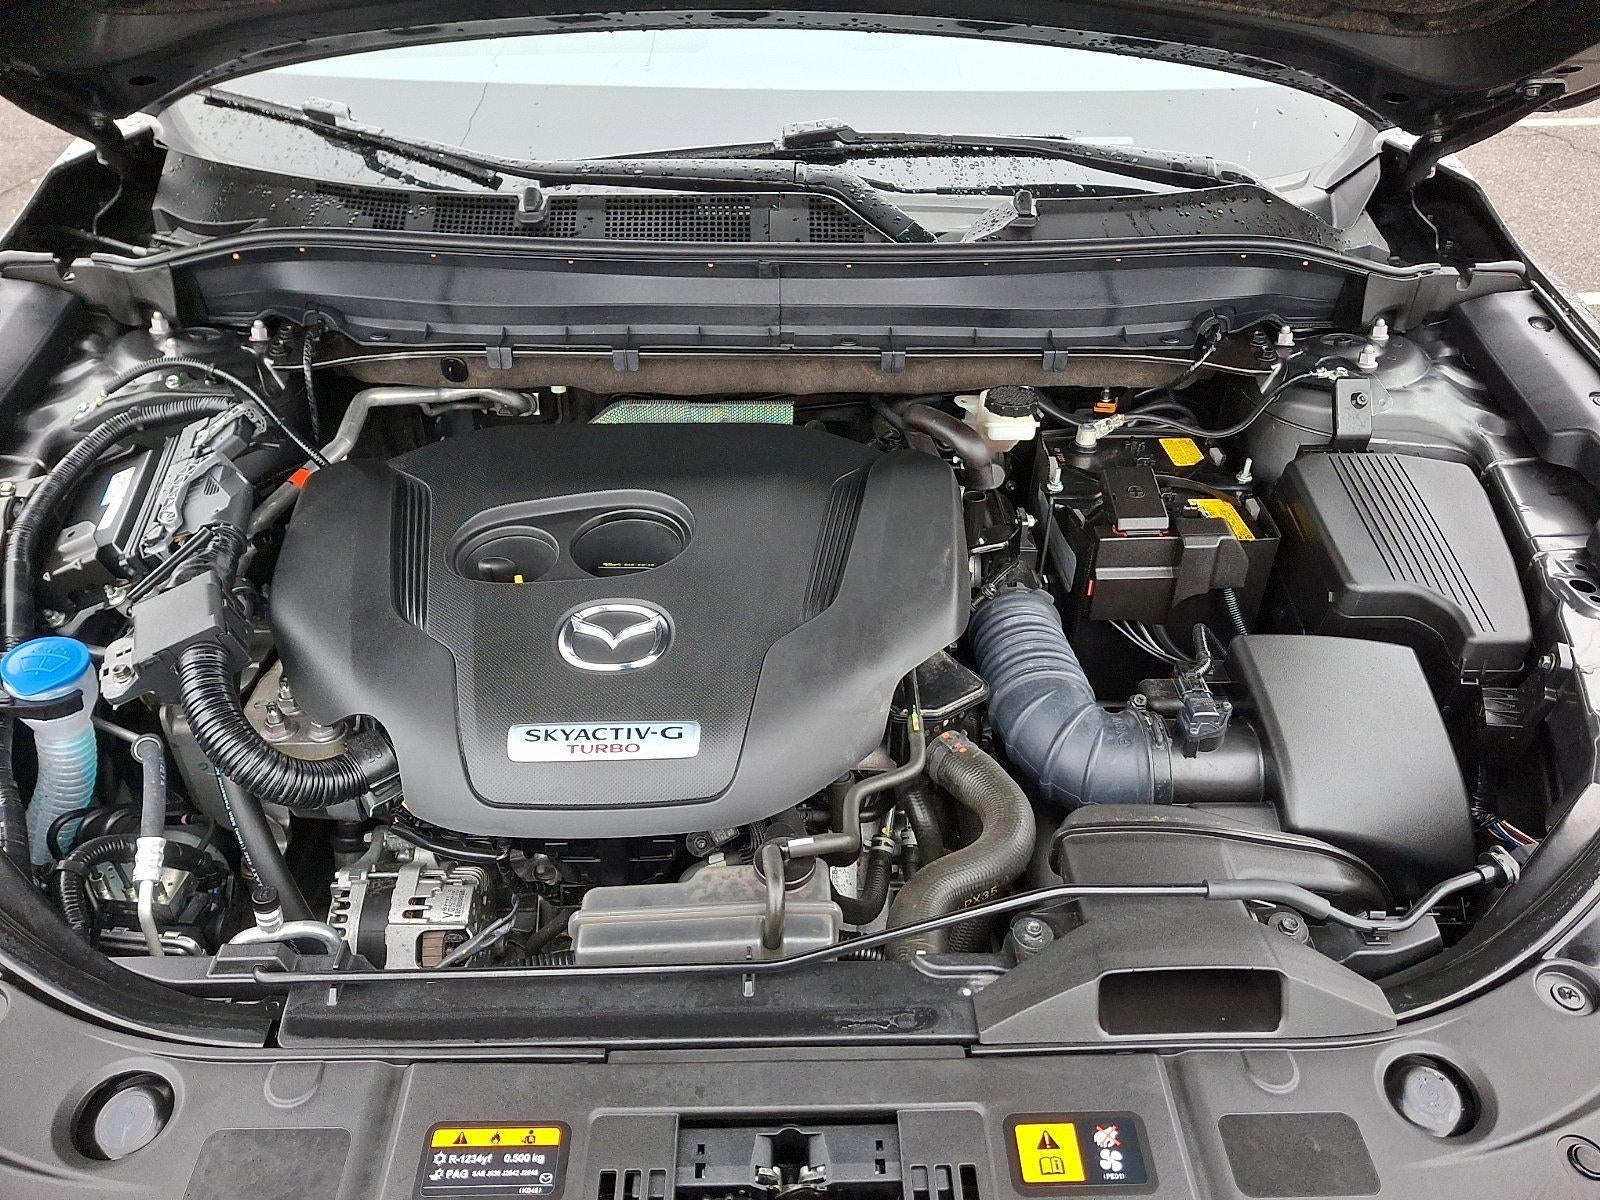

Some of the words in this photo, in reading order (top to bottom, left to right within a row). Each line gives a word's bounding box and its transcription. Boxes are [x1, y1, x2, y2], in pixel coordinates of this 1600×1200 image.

[525, 726, 684, 742] SKYACTIV-G
[567, 743, 641, 755] TURBO
[448, 1154, 493, 1166] R-1234yf
[503, 1154, 531, 1163] 0.500
[445, 1169, 469, 1179] PAG
